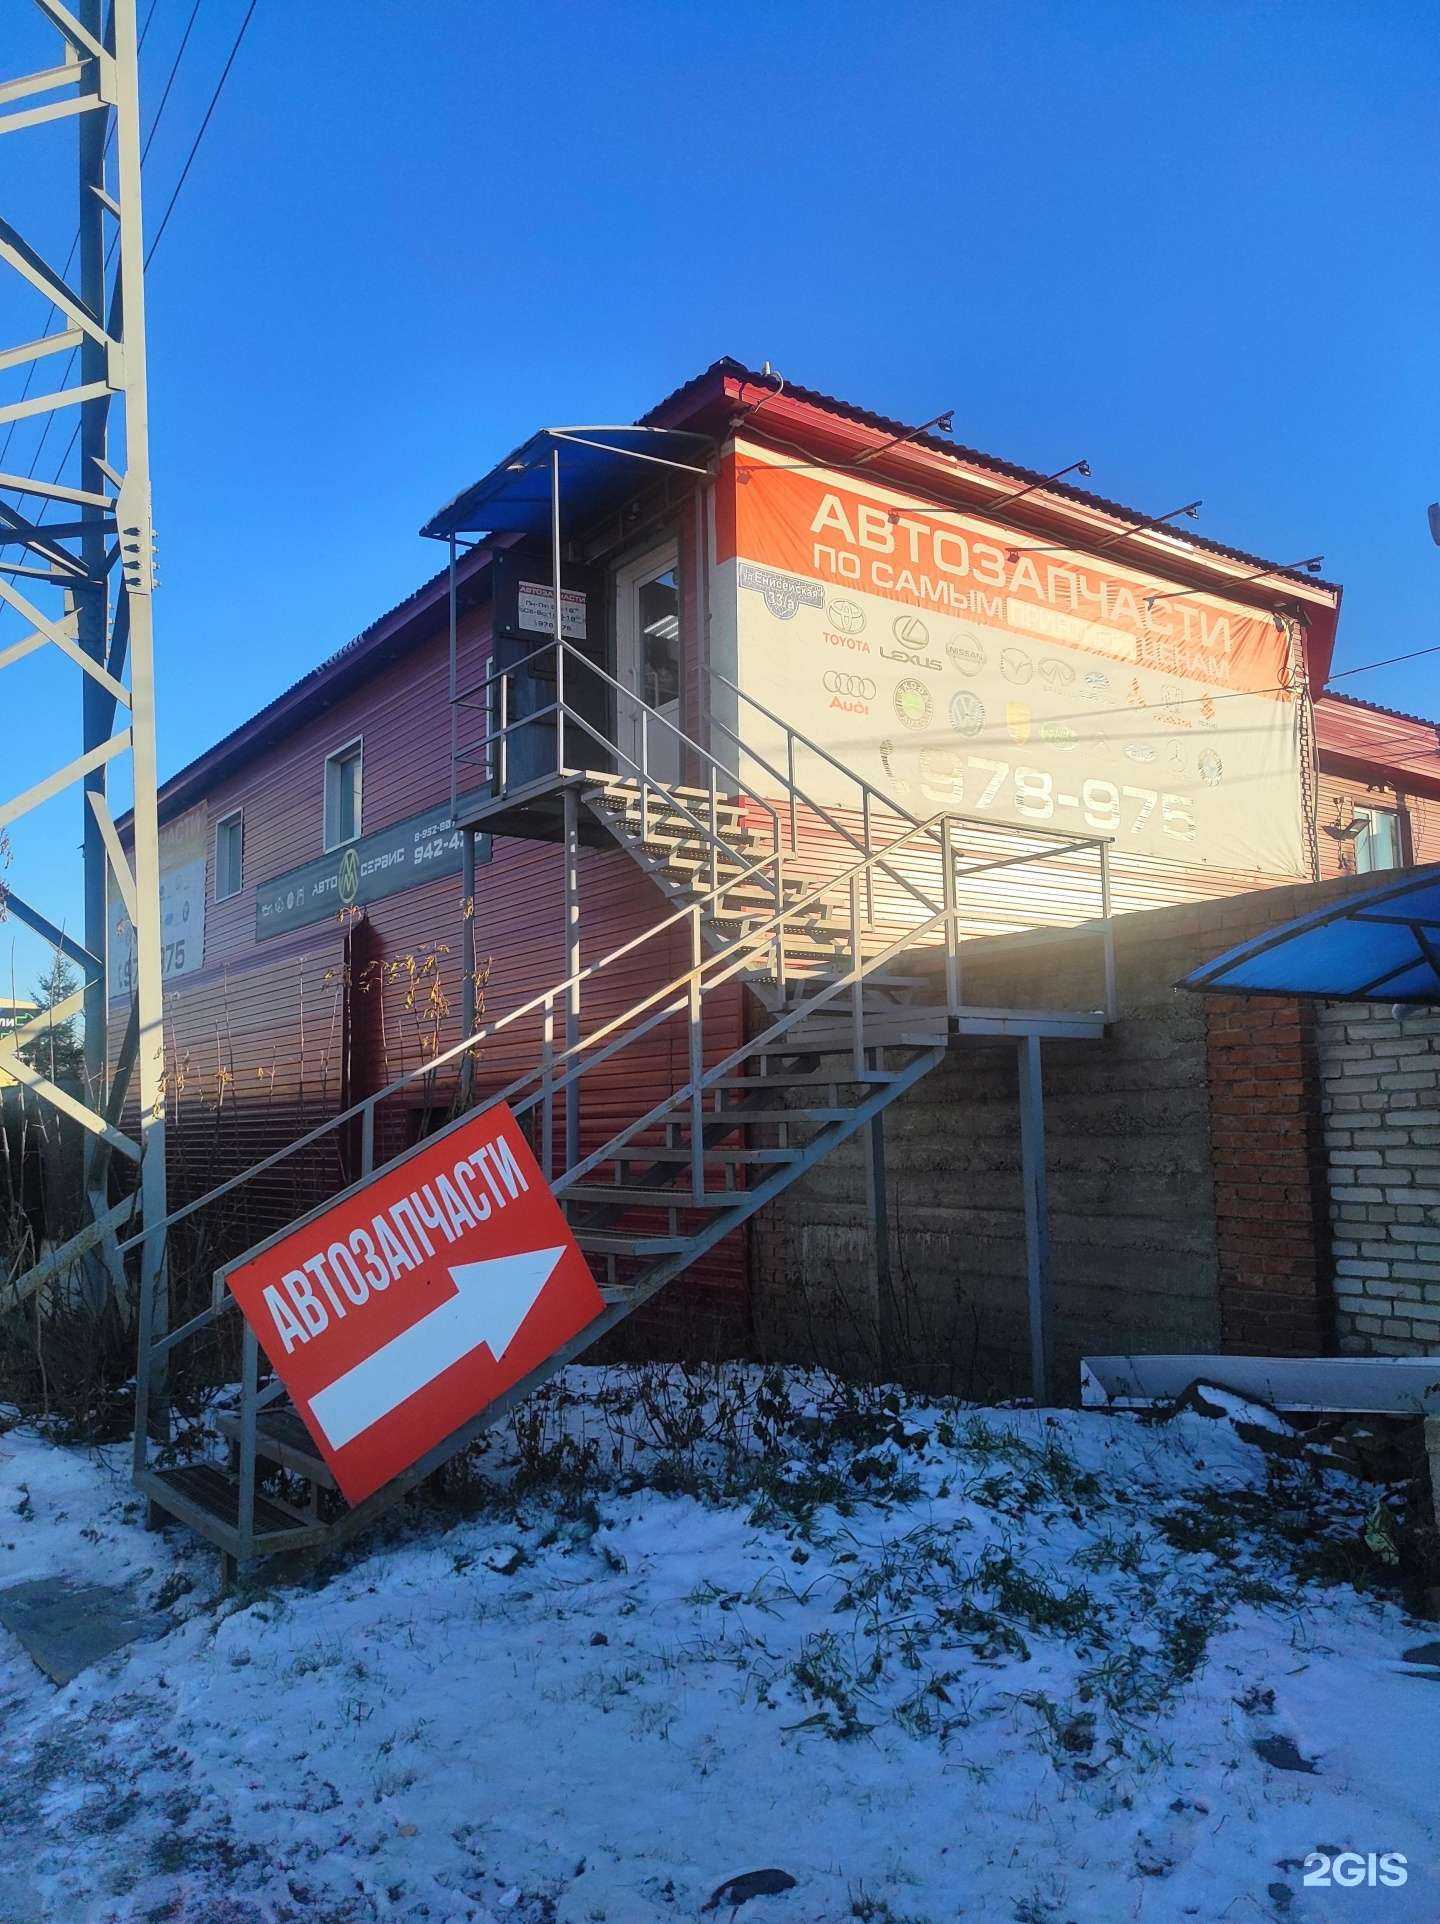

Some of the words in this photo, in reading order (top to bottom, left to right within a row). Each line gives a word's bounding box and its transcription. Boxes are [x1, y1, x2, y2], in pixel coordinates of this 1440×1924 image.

[809, 493, 1231, 653] АВТОЗАПЧАСТИ
[813, 544, 861, 580] ПО
[871, 561, 1001, 618] САМЫМ
[822, 631, 871, 654] TOYOTA
[919, 745, 1199, 842] 978-975
[312, 876, 338, 896] АВТО
[360, 847, 405, 877] СЕРВИС
[262, 1135, 530, 1354] АВТОЗАПЧАСТИ
